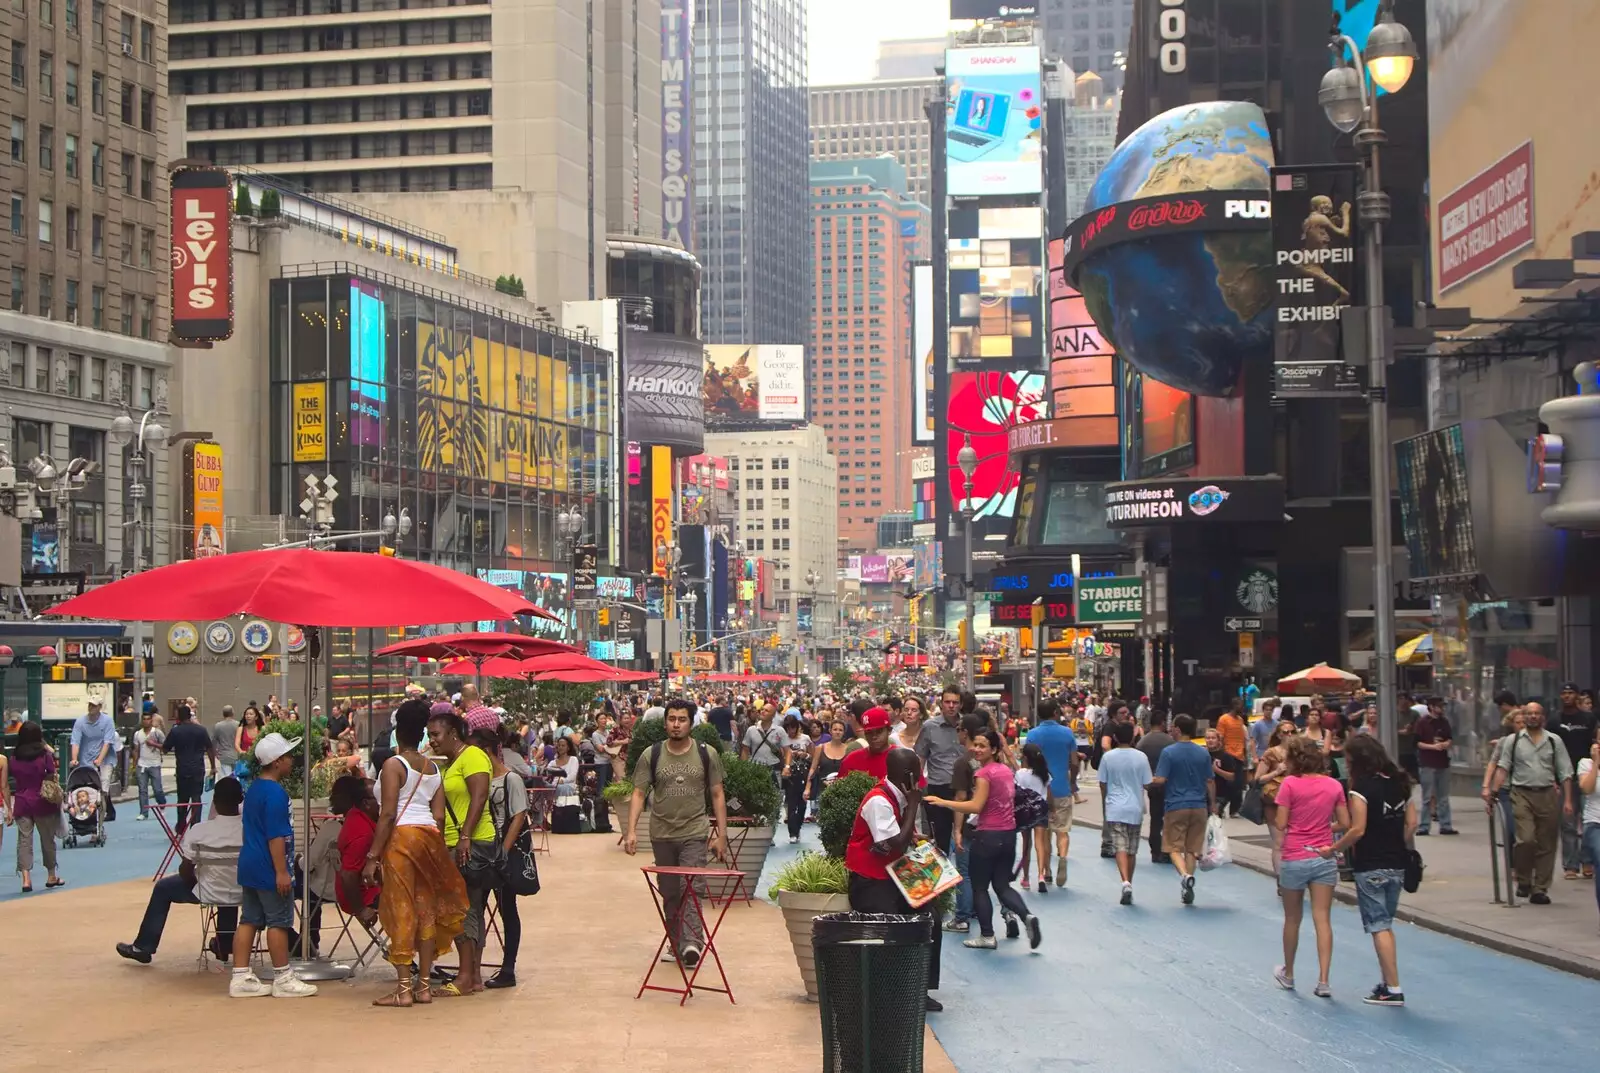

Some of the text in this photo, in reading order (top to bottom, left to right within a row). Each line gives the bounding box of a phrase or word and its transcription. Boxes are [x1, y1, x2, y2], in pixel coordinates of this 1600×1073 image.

[1160, 0, 1186, 73] 00
[661, 9, 685, 133] TIMES
[1225, 200, 1271, 218] PUD
[1276, 248, 1353, 266] POMPEII
[1277, 278, 1314, 294] THE
[300, 397, 319, 409] THE
[296, 412, 322, 430] LION
[297, 432, 323, 452] KING
[195, 451, 222, 471] BUBBA
[197, 474, 220, 492] GUMP
[1135, 489, 1162, 501] videos
[1163, 488, 1175, 499] at
[1048, 603, 1069, 618] TO
[1094, 600, 1143, 613] COFFEE
[243, 655, 259, 664] FO
